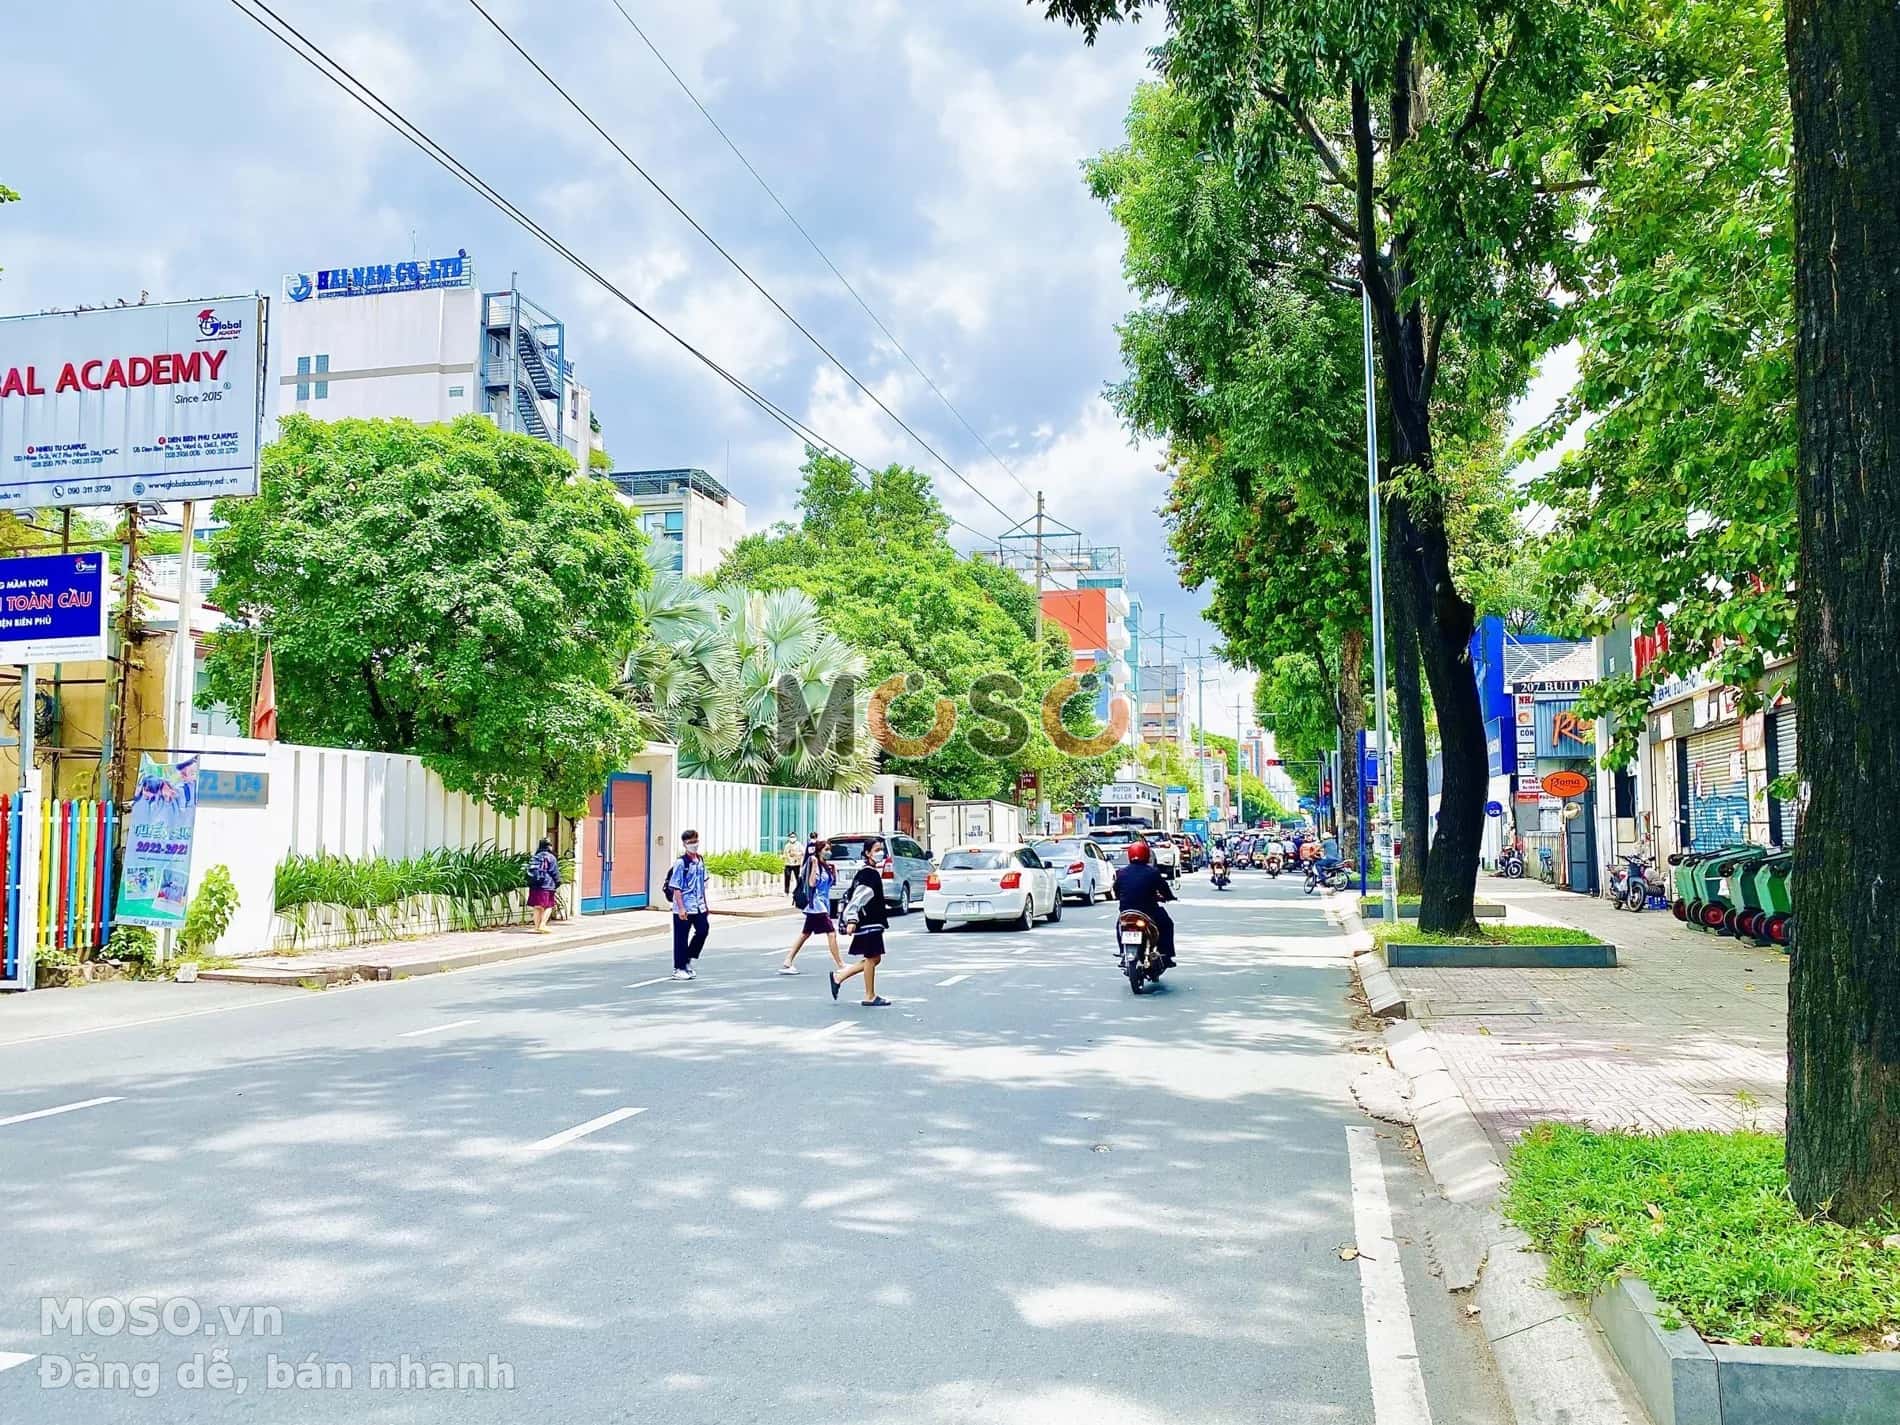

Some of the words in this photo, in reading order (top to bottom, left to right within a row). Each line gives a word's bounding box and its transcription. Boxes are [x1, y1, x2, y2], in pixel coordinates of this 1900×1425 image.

[353, 264, 392, 287] NAM
[56, 350, 227, 394] ACADEMY
[175, 394, 198, 405] Since
[202, 391, 222, 402] 2015
[211, 432, 238, 440] CAMPUS
[68, 486, 80, 494] 090
[82, 486, 93, 494] 311
[95, 485, 111, 493] 3739
[28, 579, 48, 588] NON
[7, 590, 54, 612] TOÀN
[58, 587, 93, 608] CẦU
[35, 614, 52, 626] PHỦ
[1520, 682, 1541, 693] 207
